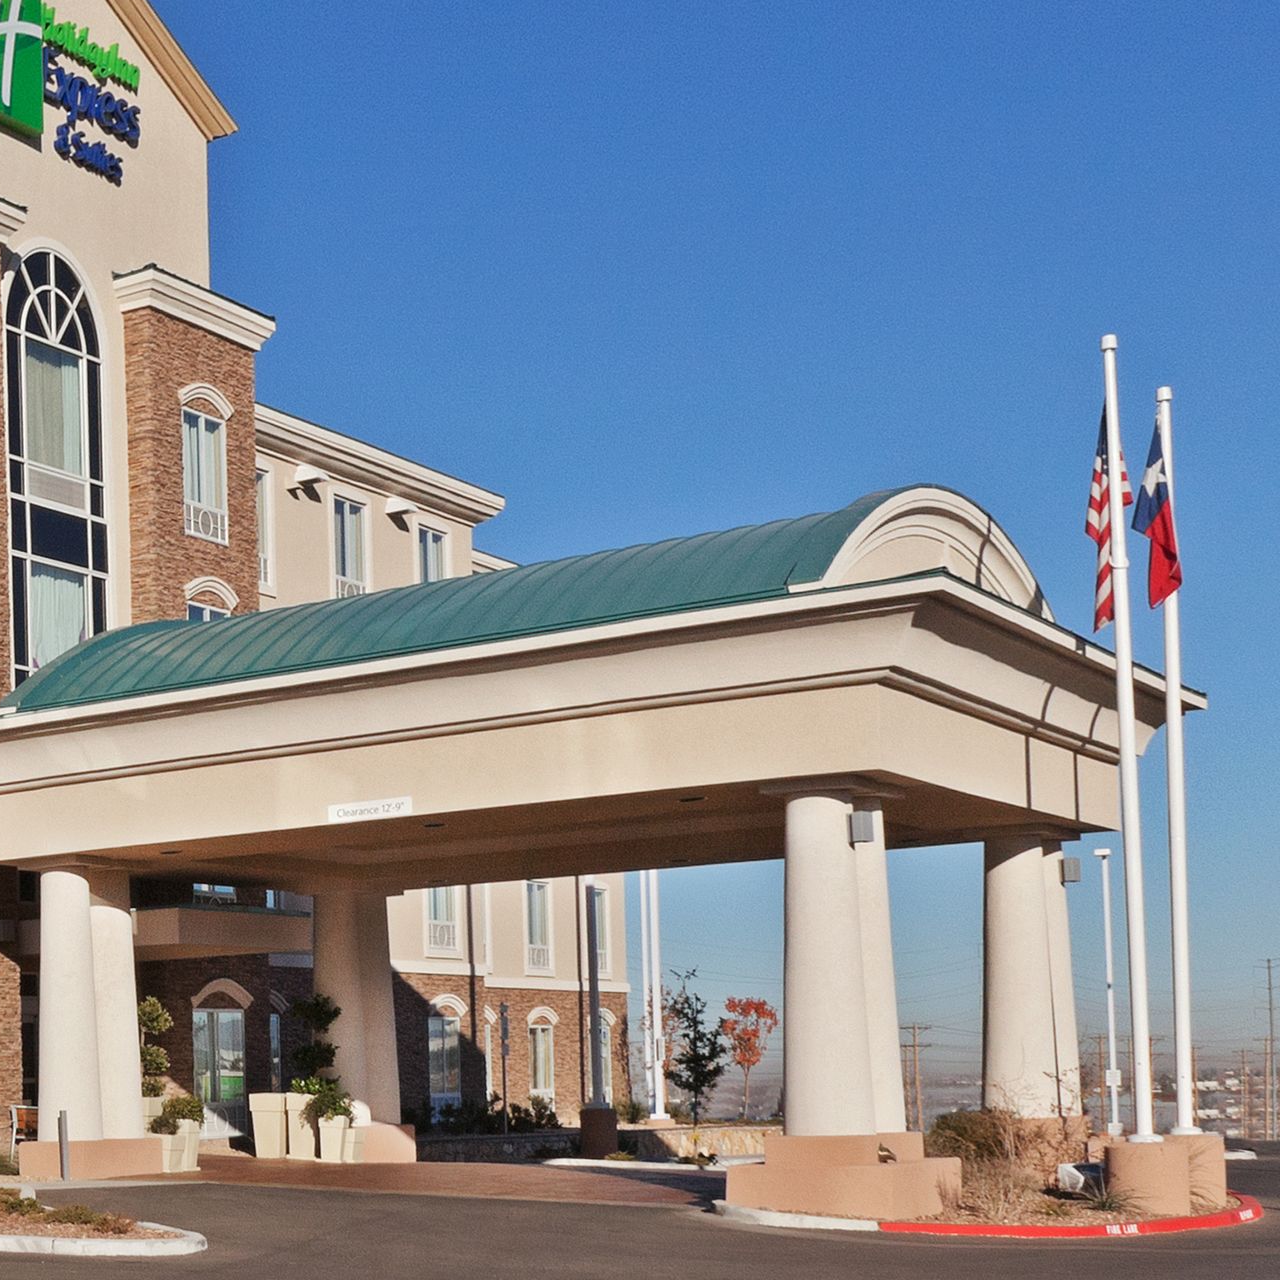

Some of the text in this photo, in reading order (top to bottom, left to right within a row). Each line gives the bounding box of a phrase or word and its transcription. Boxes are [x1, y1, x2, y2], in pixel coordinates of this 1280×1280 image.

[42, 3, 141, 93] Holiday Inn
[43, 46, 141, 145] Express
[54, 123, 123, 183] & Suites
[336, 806, 379, 818] Clearance
